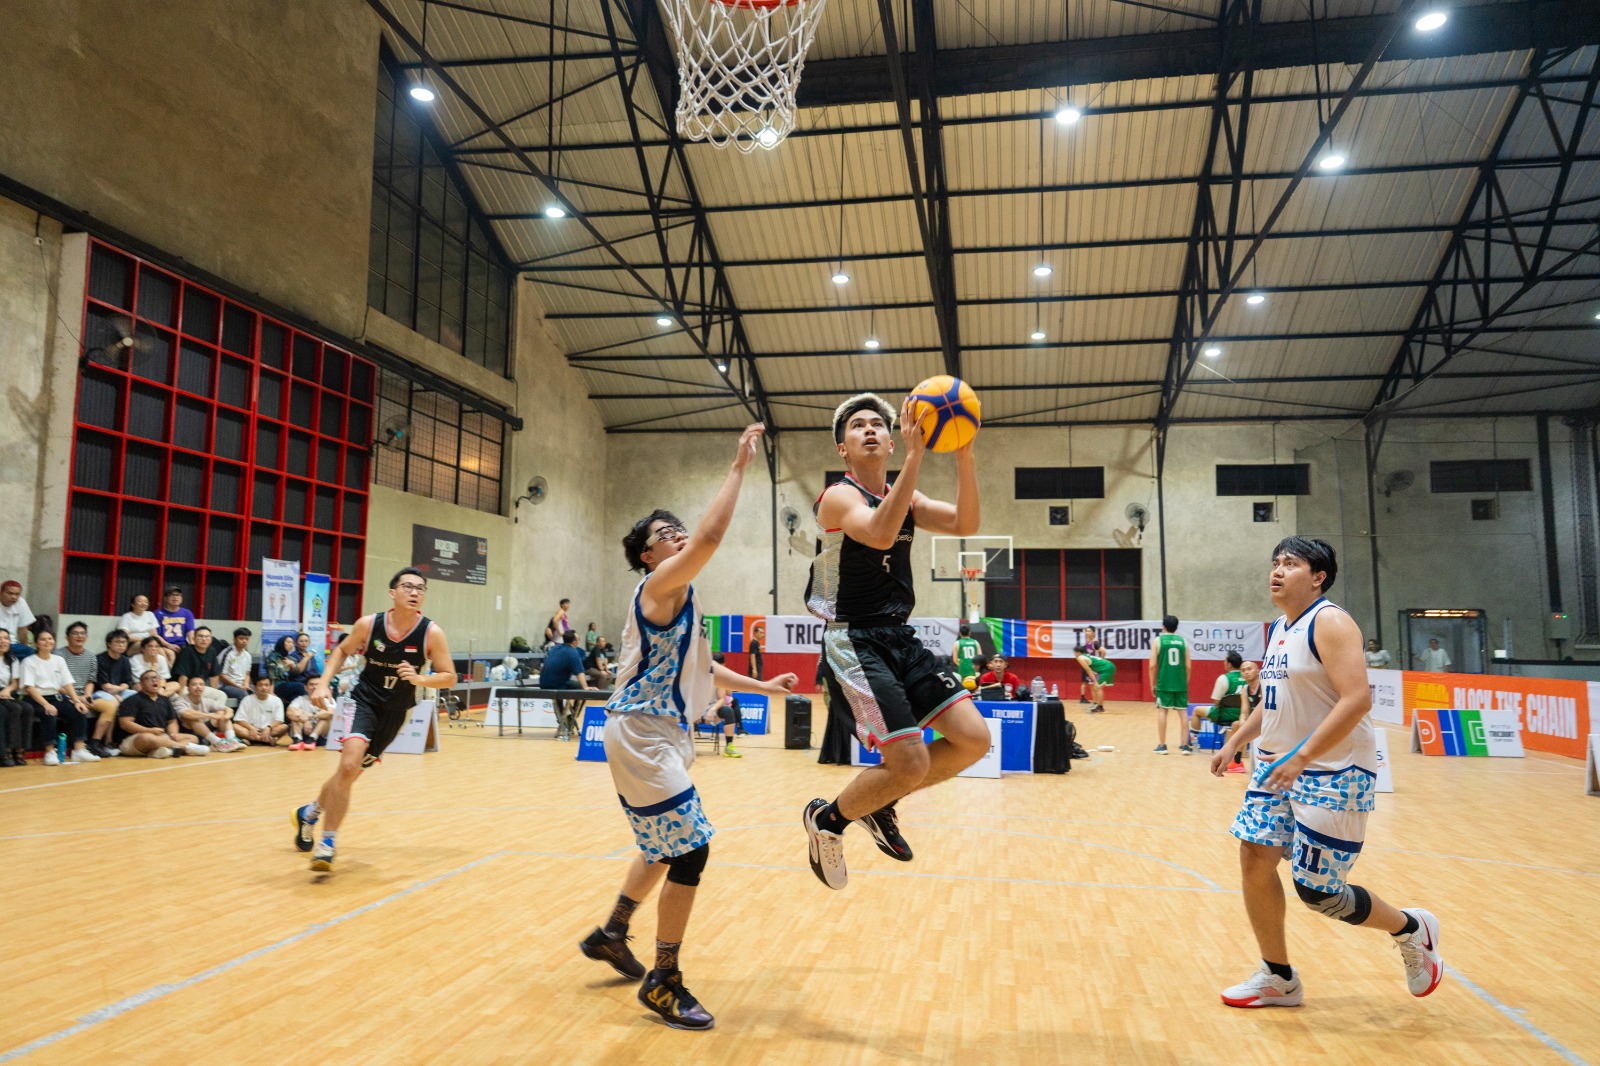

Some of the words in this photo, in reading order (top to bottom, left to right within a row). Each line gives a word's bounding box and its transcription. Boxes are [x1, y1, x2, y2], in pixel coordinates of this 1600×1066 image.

[882, 555, 891, 573] 5
[164, 624, 183, 638] 24
[785, 623, 823, 645] TRIC
[913, 625, 941, 636] NTU
[923, 640, 941, 648] 025
[1073, 628, 1162, 650] TICOURT
[962, 646, 975, 659] 10
[1194, 643, 1216, 652] CUP
[1218, 643, 1245, 652] 2025
[1168, 648, 1179, 666] 0
[937, 672, 956, 688] 5
[1260, 670, 1289, 680] NDONESIA
[383, 676, 399, 689] 17
[1264, 685, 1277, 710] 11
[740, 707, 764, 720] OURT
[992, 709, 1024, 719] TRICOURT
[1526, 693, 1577, 739] CHAIN
[585, 726, 604, 741] OW
[1298, 843, 1321, 874] 11
